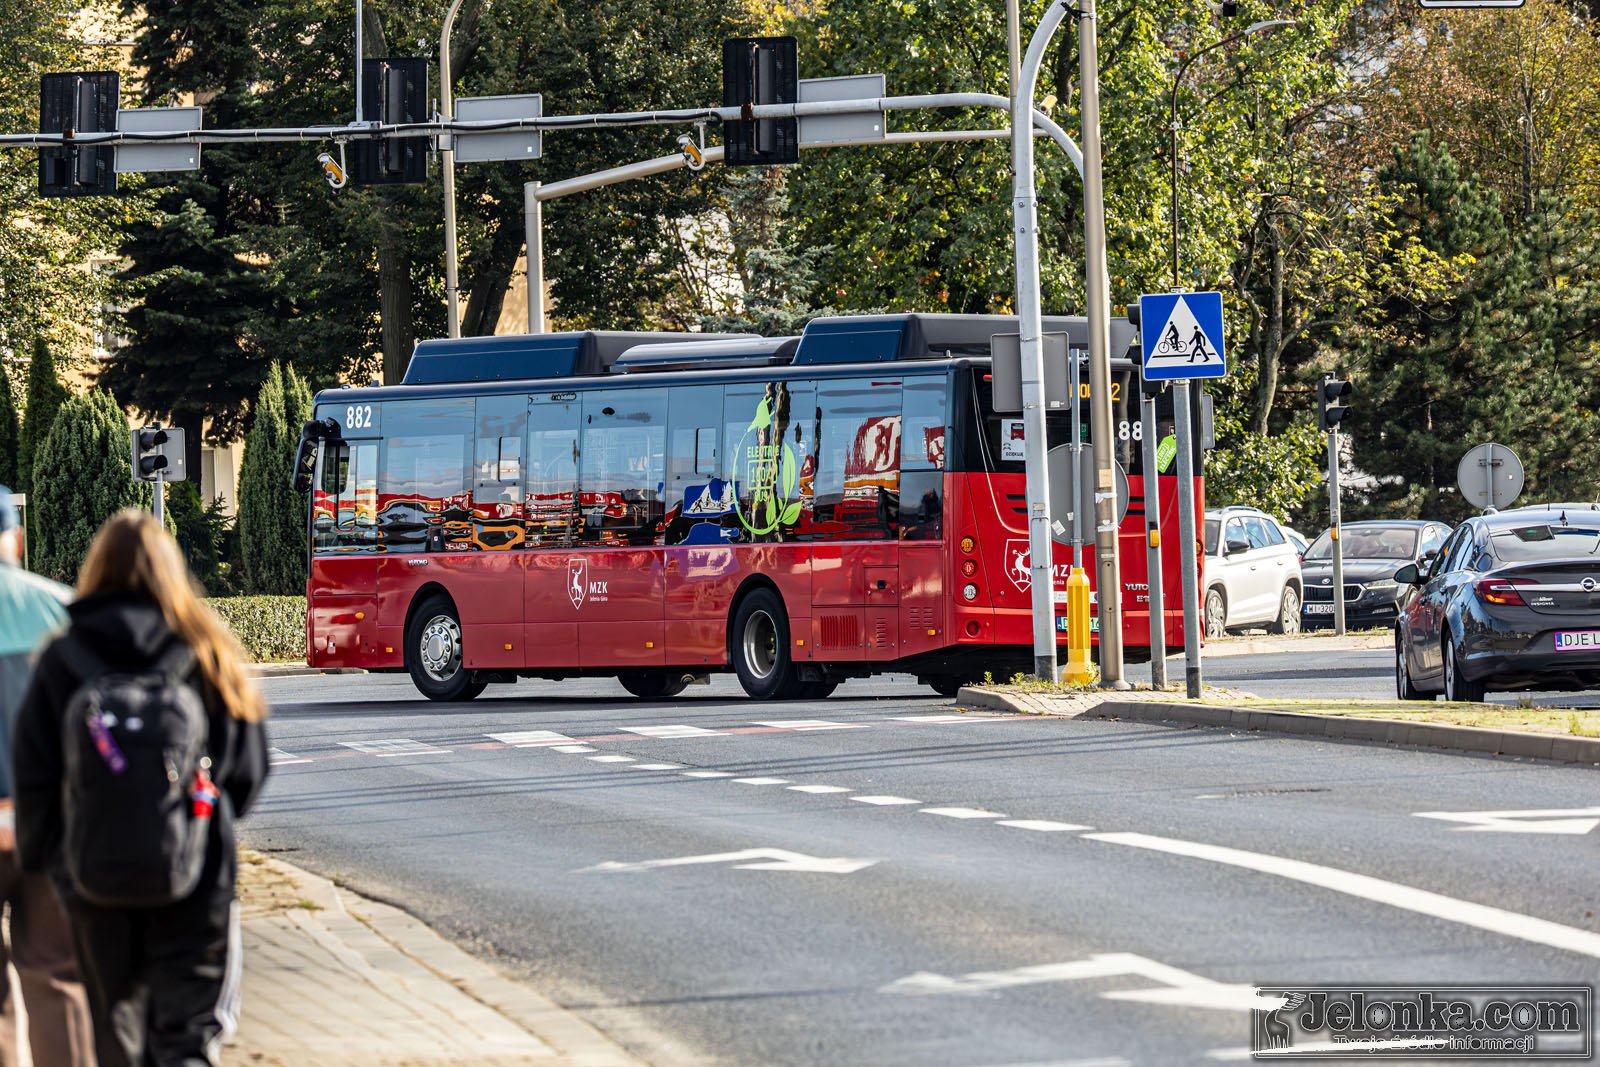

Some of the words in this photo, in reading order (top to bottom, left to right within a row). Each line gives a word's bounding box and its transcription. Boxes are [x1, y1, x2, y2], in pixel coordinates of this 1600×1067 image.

[346, 405, 372, 428] 882
[1119, 421, 1143, 441] 88
[1053, 564, 1073, 577] MZ
[590, 581, 608, 594] MZK
[1125, 583, 1150, 591] YUTO
[1320, 605, 1335, 614] 320
[1564, 633, 1589, 646] DJE
